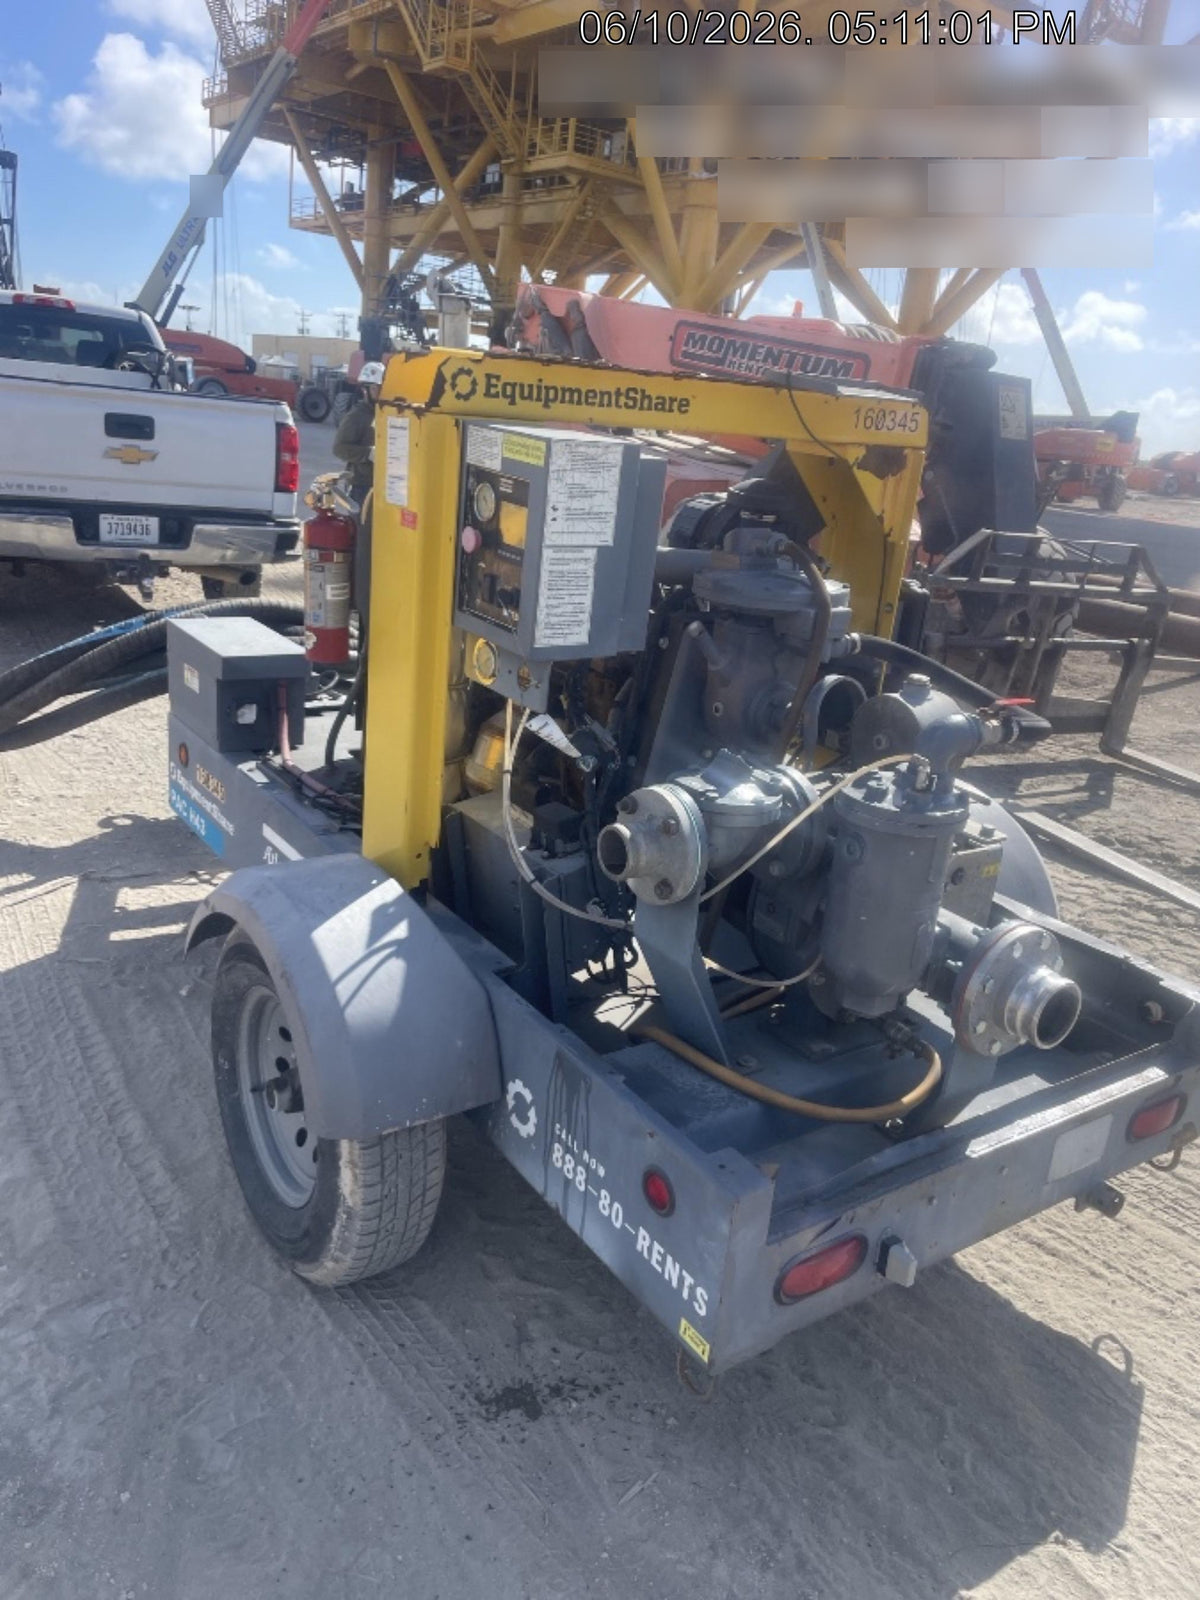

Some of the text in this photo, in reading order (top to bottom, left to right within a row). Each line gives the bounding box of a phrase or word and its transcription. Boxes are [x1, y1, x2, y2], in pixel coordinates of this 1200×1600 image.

[162, 251, 178, 278] JLG
[682, 330, 856, 378] MOMENTUM
[725, 356, 766, 377] RENT
[483, 373, 691, 414] EquipmentShare
[852, 406, 921, 433] 160345
[555, 1123, 606, 1178] CALL NOW
[552, 1142, 709, 1316] 888-80-RENTS
